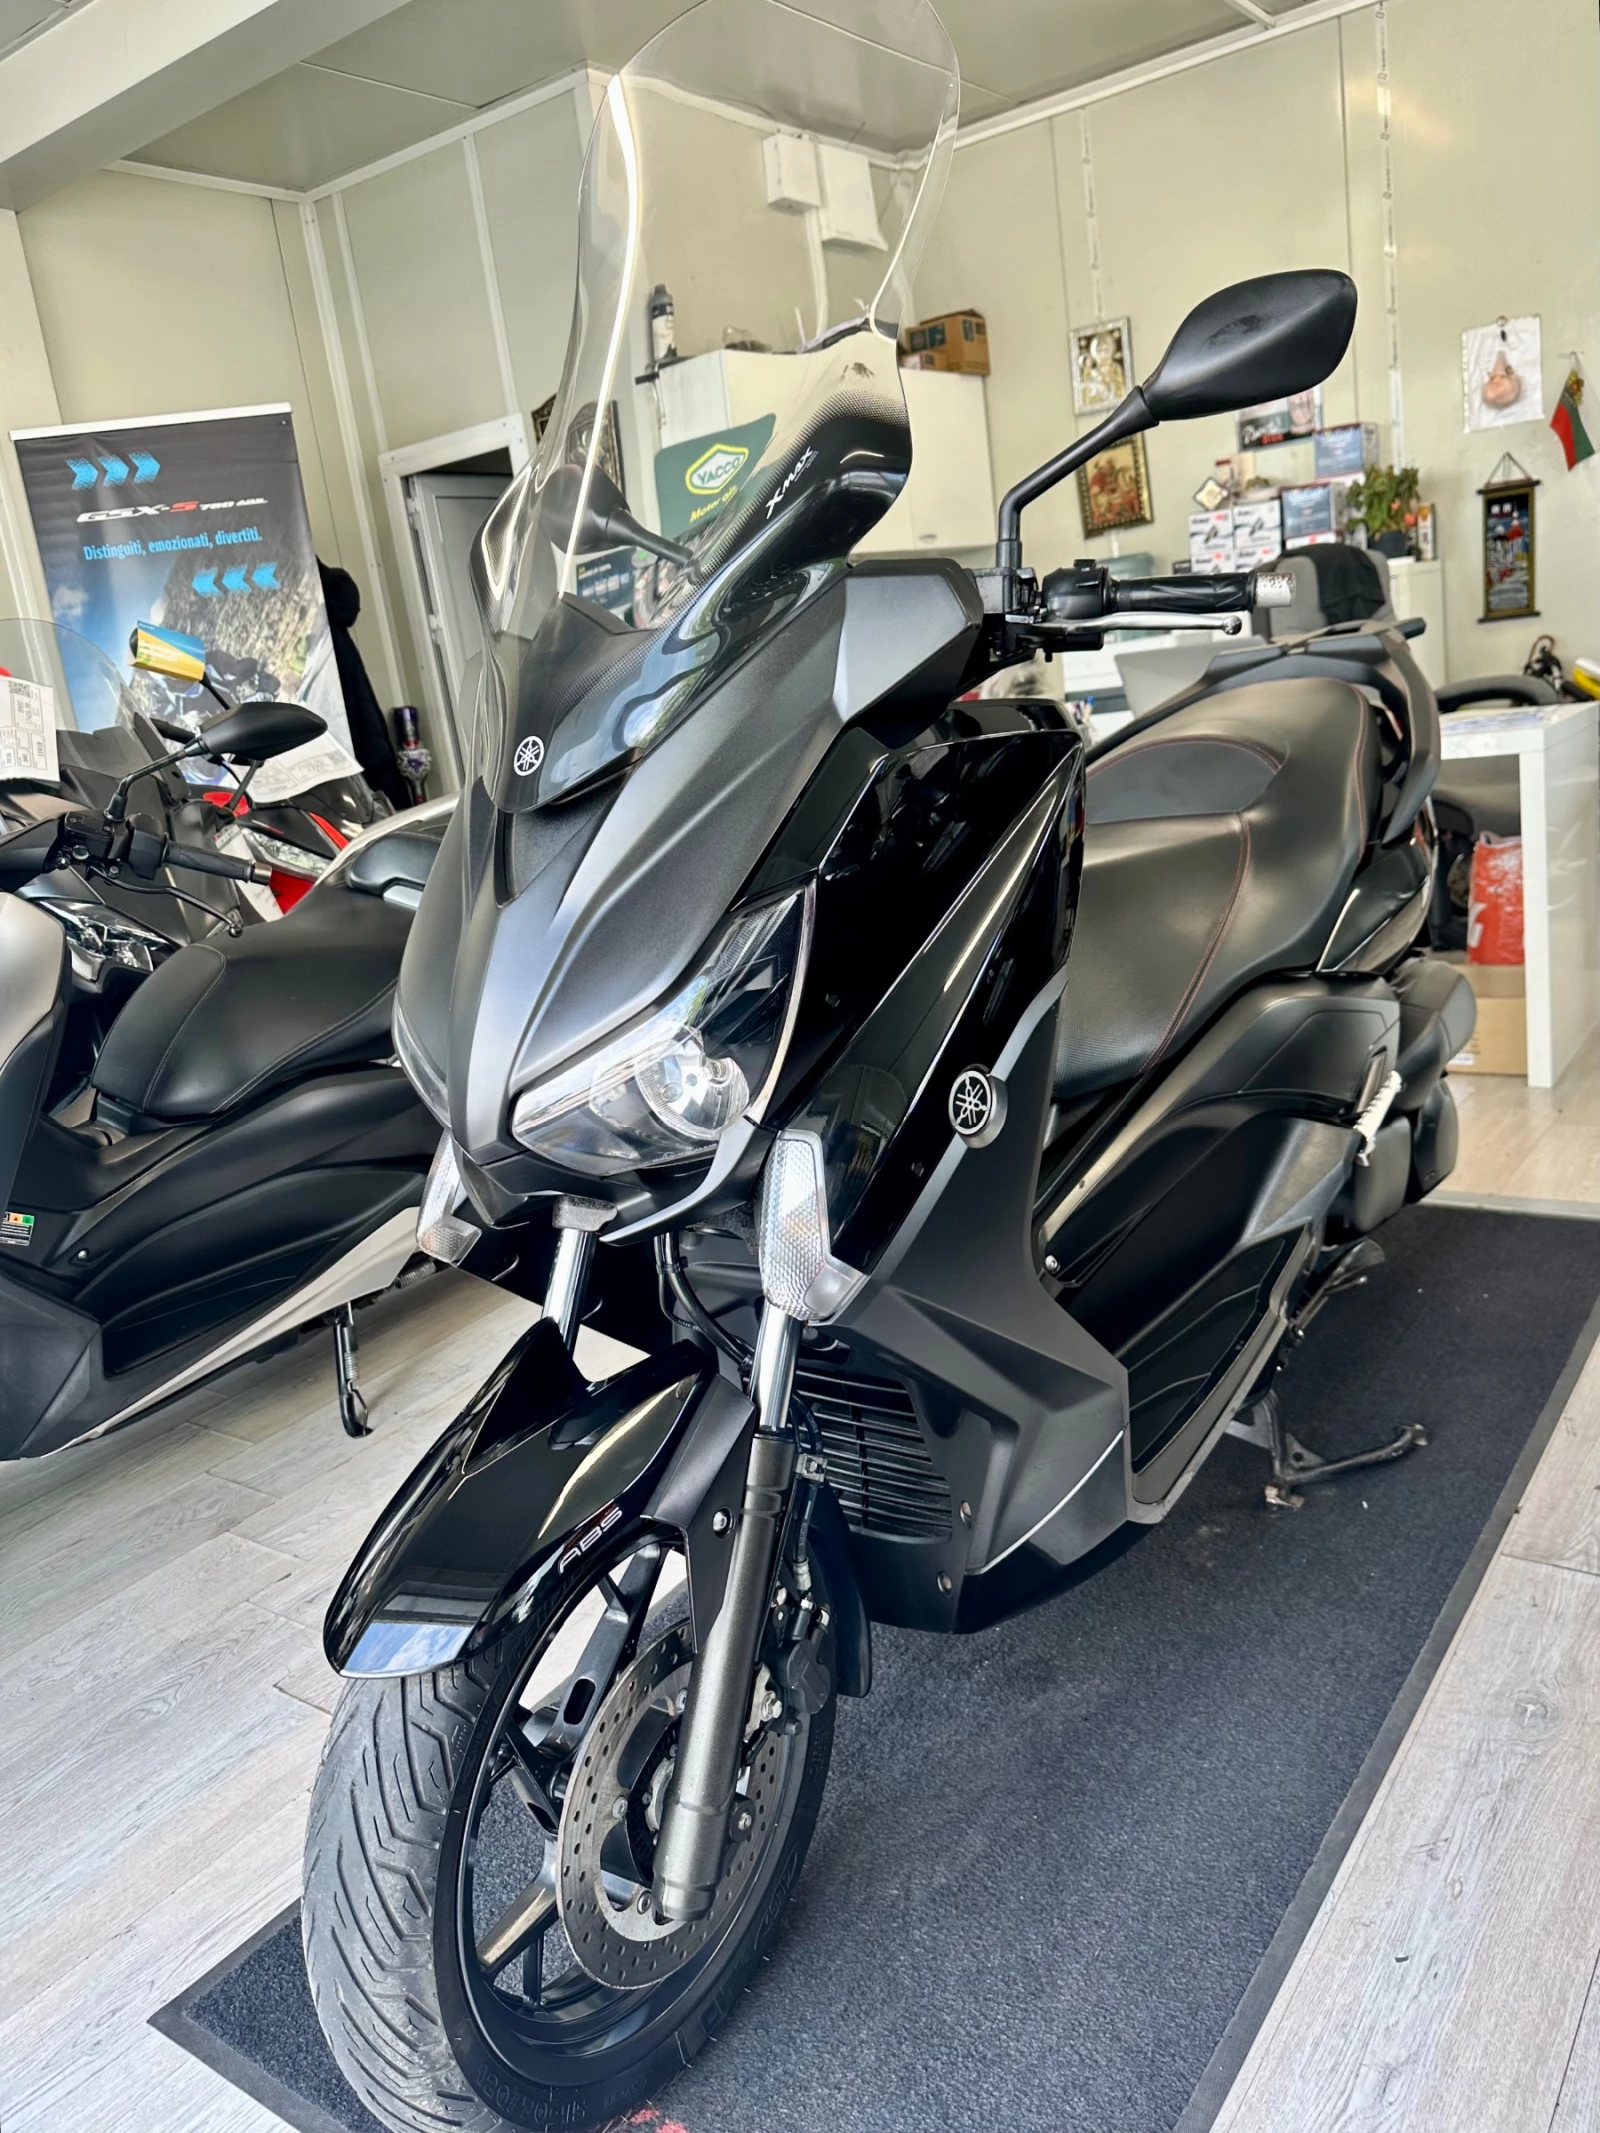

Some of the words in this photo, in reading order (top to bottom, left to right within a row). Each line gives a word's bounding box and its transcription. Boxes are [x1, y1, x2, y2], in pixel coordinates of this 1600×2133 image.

[697, 456, 741, 485] YACCO
[77, 501, 199, 522] GSX-S
[83, 540, 147, 560] Distinguiti,
[148, 532, 213, 553] emozionati,
[215, 526, 262, 546] divertiti.
[559, 1506, 622, 1574] ABS
